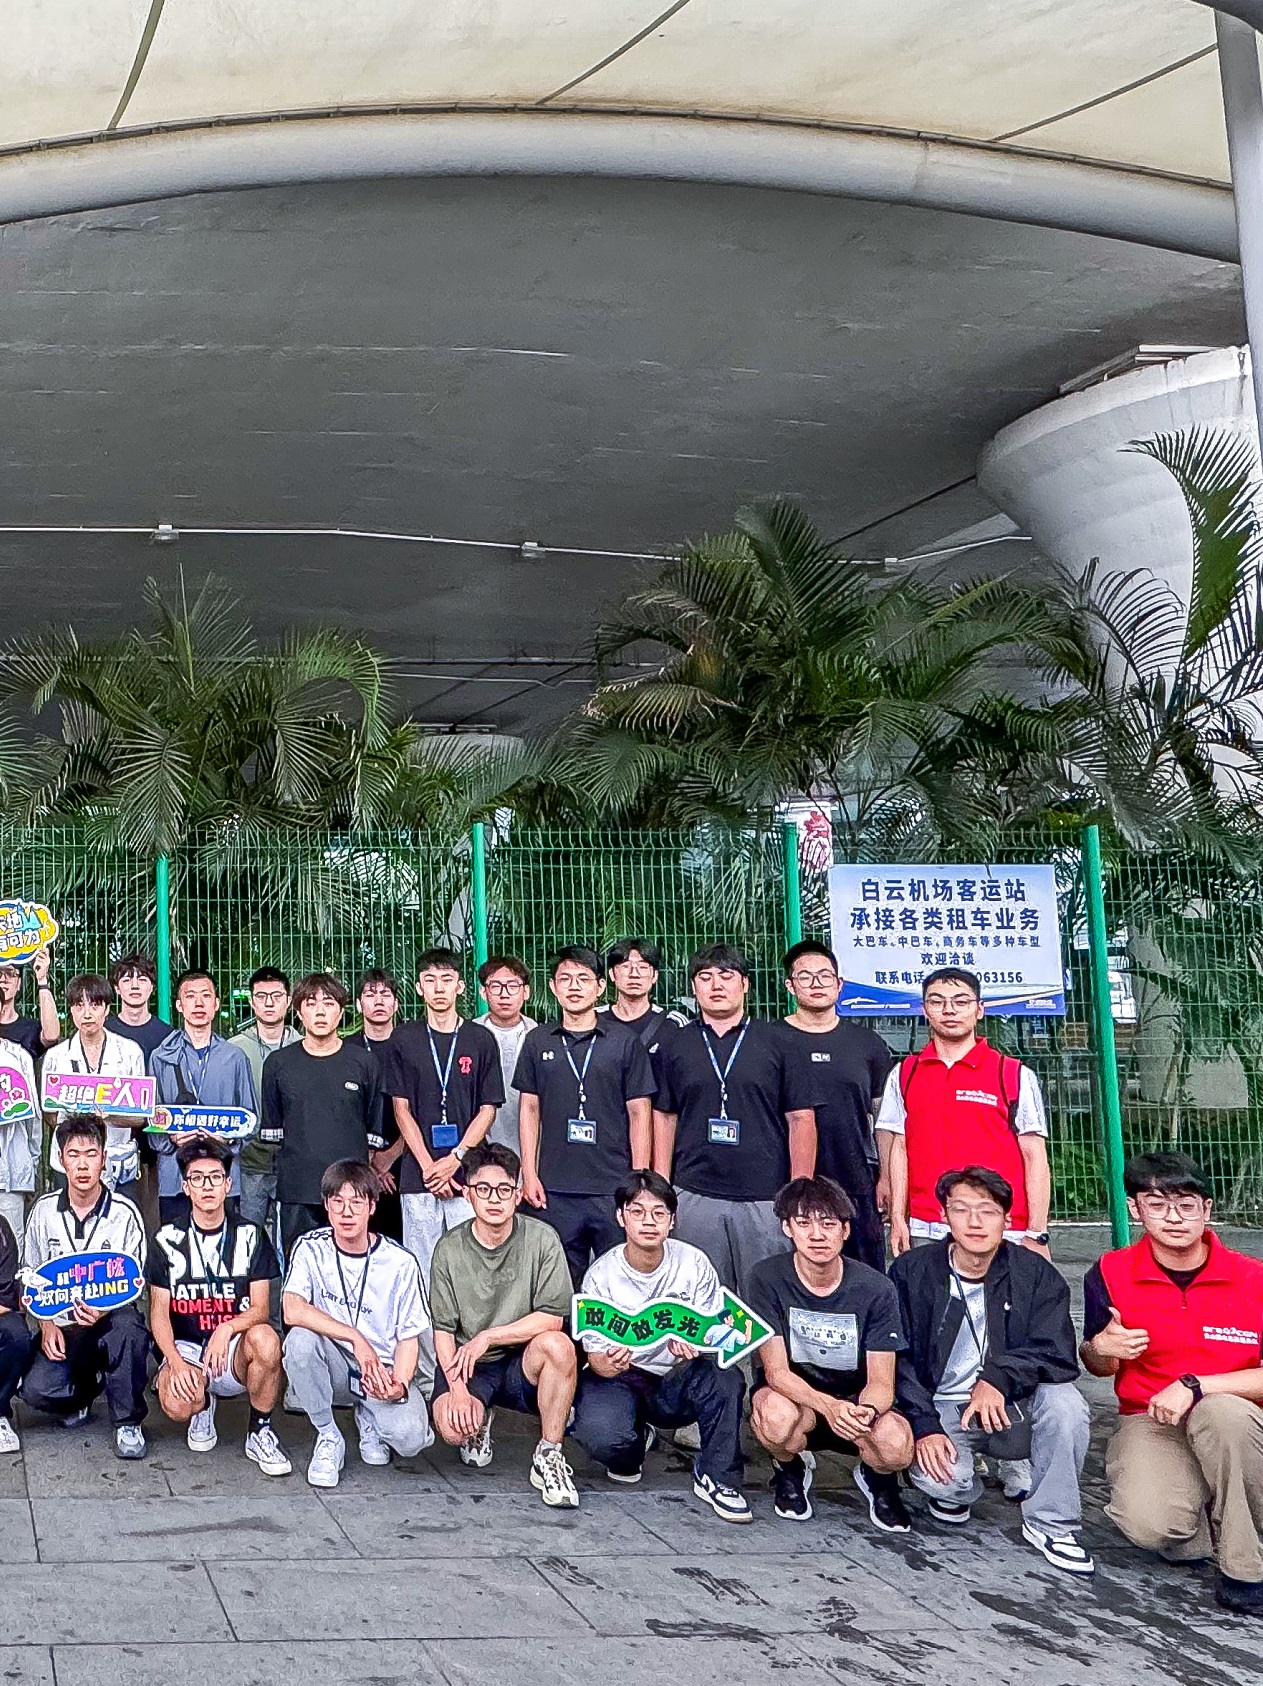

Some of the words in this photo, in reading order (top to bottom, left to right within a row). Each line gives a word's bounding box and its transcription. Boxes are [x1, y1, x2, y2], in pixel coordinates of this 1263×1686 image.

[861, 878, 1026, 901] 白云机场客运站
[850, 907, 1040, 931] 承接各类租车业务
[921, 953, 975, 966] 欢迎洽谈
[875, 971, 924, 985] 联系电话
[239, 1297, 250, 1312] &
